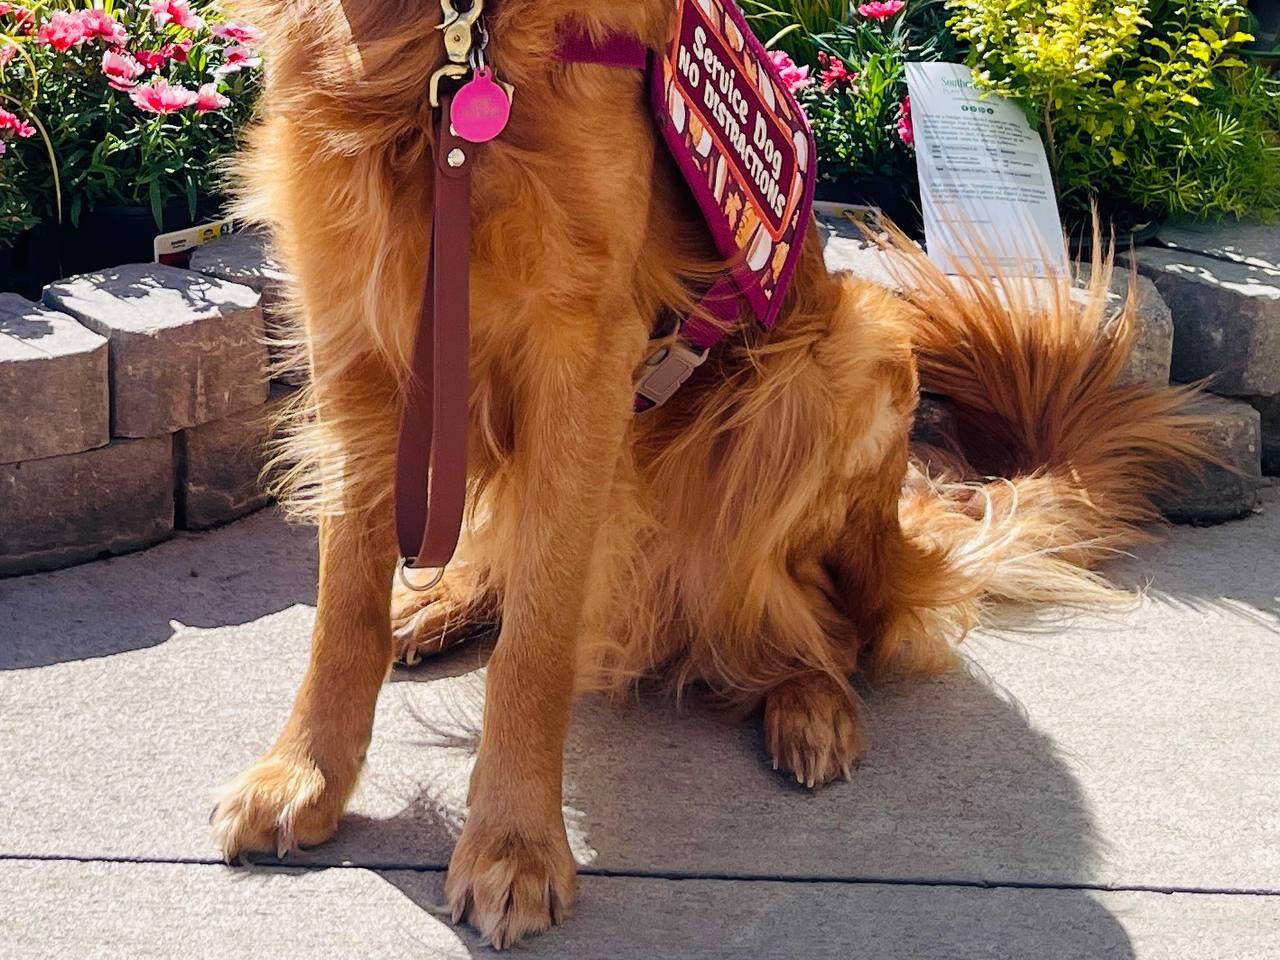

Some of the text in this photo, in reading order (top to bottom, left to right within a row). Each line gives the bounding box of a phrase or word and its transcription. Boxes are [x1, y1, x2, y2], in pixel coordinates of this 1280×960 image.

[678, 45, 786, 219] NO DISTRACTIONS
[693, 25, 783, 181] Service Dog
